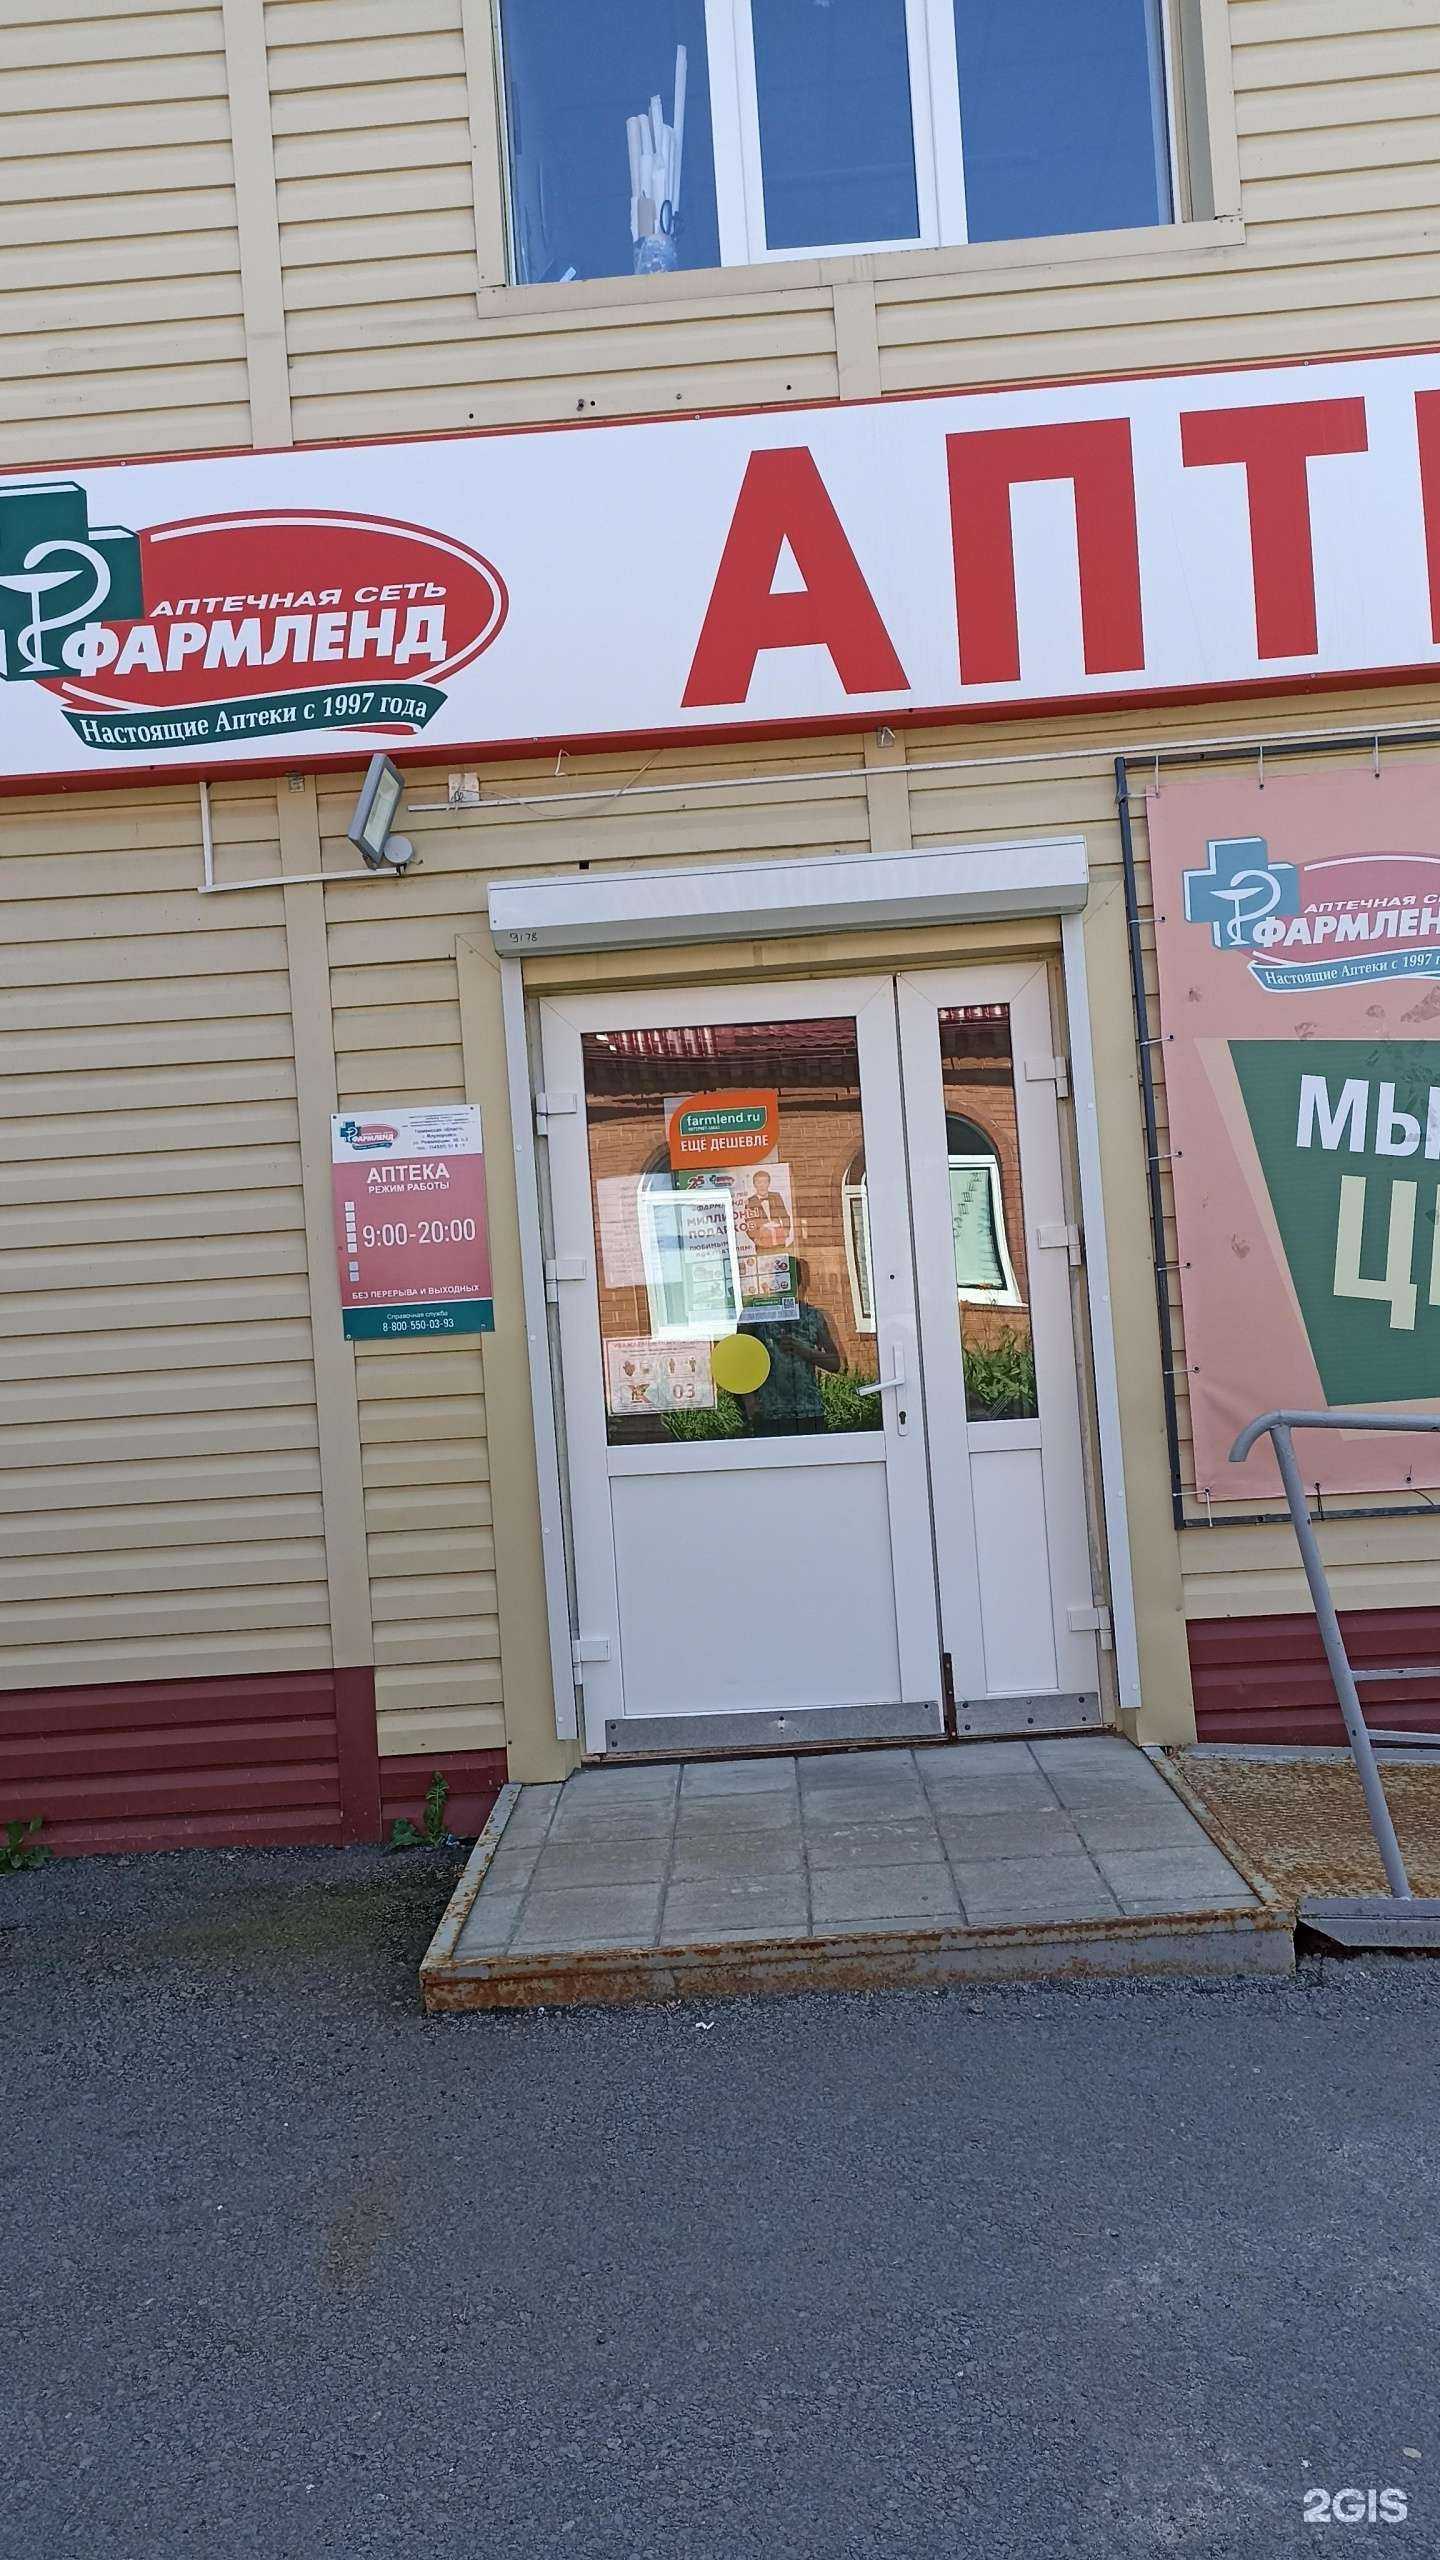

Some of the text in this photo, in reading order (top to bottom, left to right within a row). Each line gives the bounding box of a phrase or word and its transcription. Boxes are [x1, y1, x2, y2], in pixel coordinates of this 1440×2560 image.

[680, 391, 1440, 708] АПТ
[150, 581, 447, 618] АПТЕЧНАЯ СЕТЬ
[61, 603, 449, 678] ФАРМЛЕНД
[80, 692, 428, 746] Настоящие Аптеки с 1997 года
[1304, 894, 1440, 914] АПТЕЧНАЯ С
[1265, 967, 1338, 985] Настоящие
[1341, 960, 1388, 978] Аптеки
[1391, 960, 1398, 969] с
[1402, 953, 1433, 968] 1997
[687, 1112, 760, 1127] farmlend.ru
[1296, 1074, 1440, 1160] МЫ
[711, 1134, 769, 1151] ДЕШЕВЛЕ
[366, 1162, 450, 1184] АПТЕКА
[368, 1181, 450, 1194] РЕЖИМ РАБОТЫ
[362, 1218, 477, 1248] 9:00-20:00
[1333, 1175, 1440, 1330] Ц
[352, 1292, 369, 1300] БЕЗ
[371, 1289, 418, 1299] ПЕРЕРЫВА
[428, 1285, 480, 1295] ВЫХОДНЫХ
[672, 1382, 696, 1400] 03
